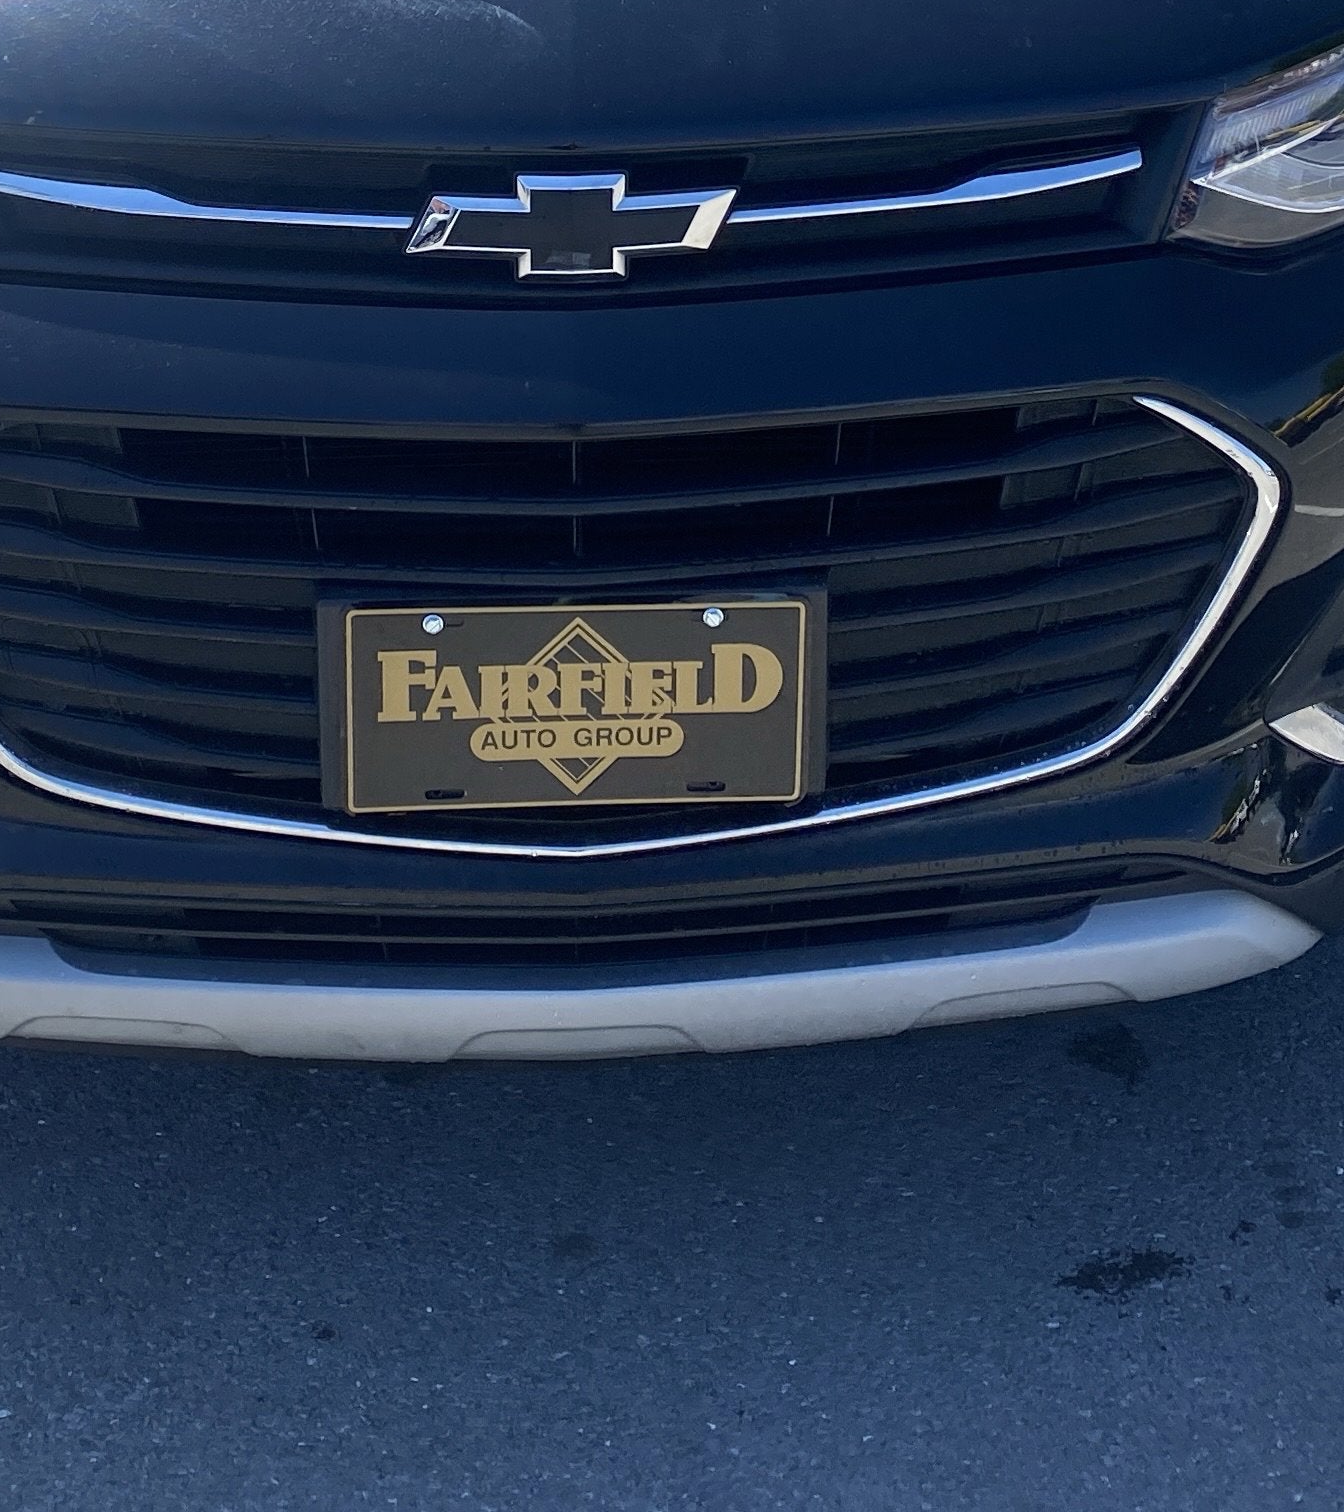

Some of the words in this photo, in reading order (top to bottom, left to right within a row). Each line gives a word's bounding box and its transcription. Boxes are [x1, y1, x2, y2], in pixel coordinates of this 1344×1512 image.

[377, 643, 784, 723] FAIRFIELD
[481, 727, 557, 751] AUTO
[573, 725, 674, 748] GROUP
